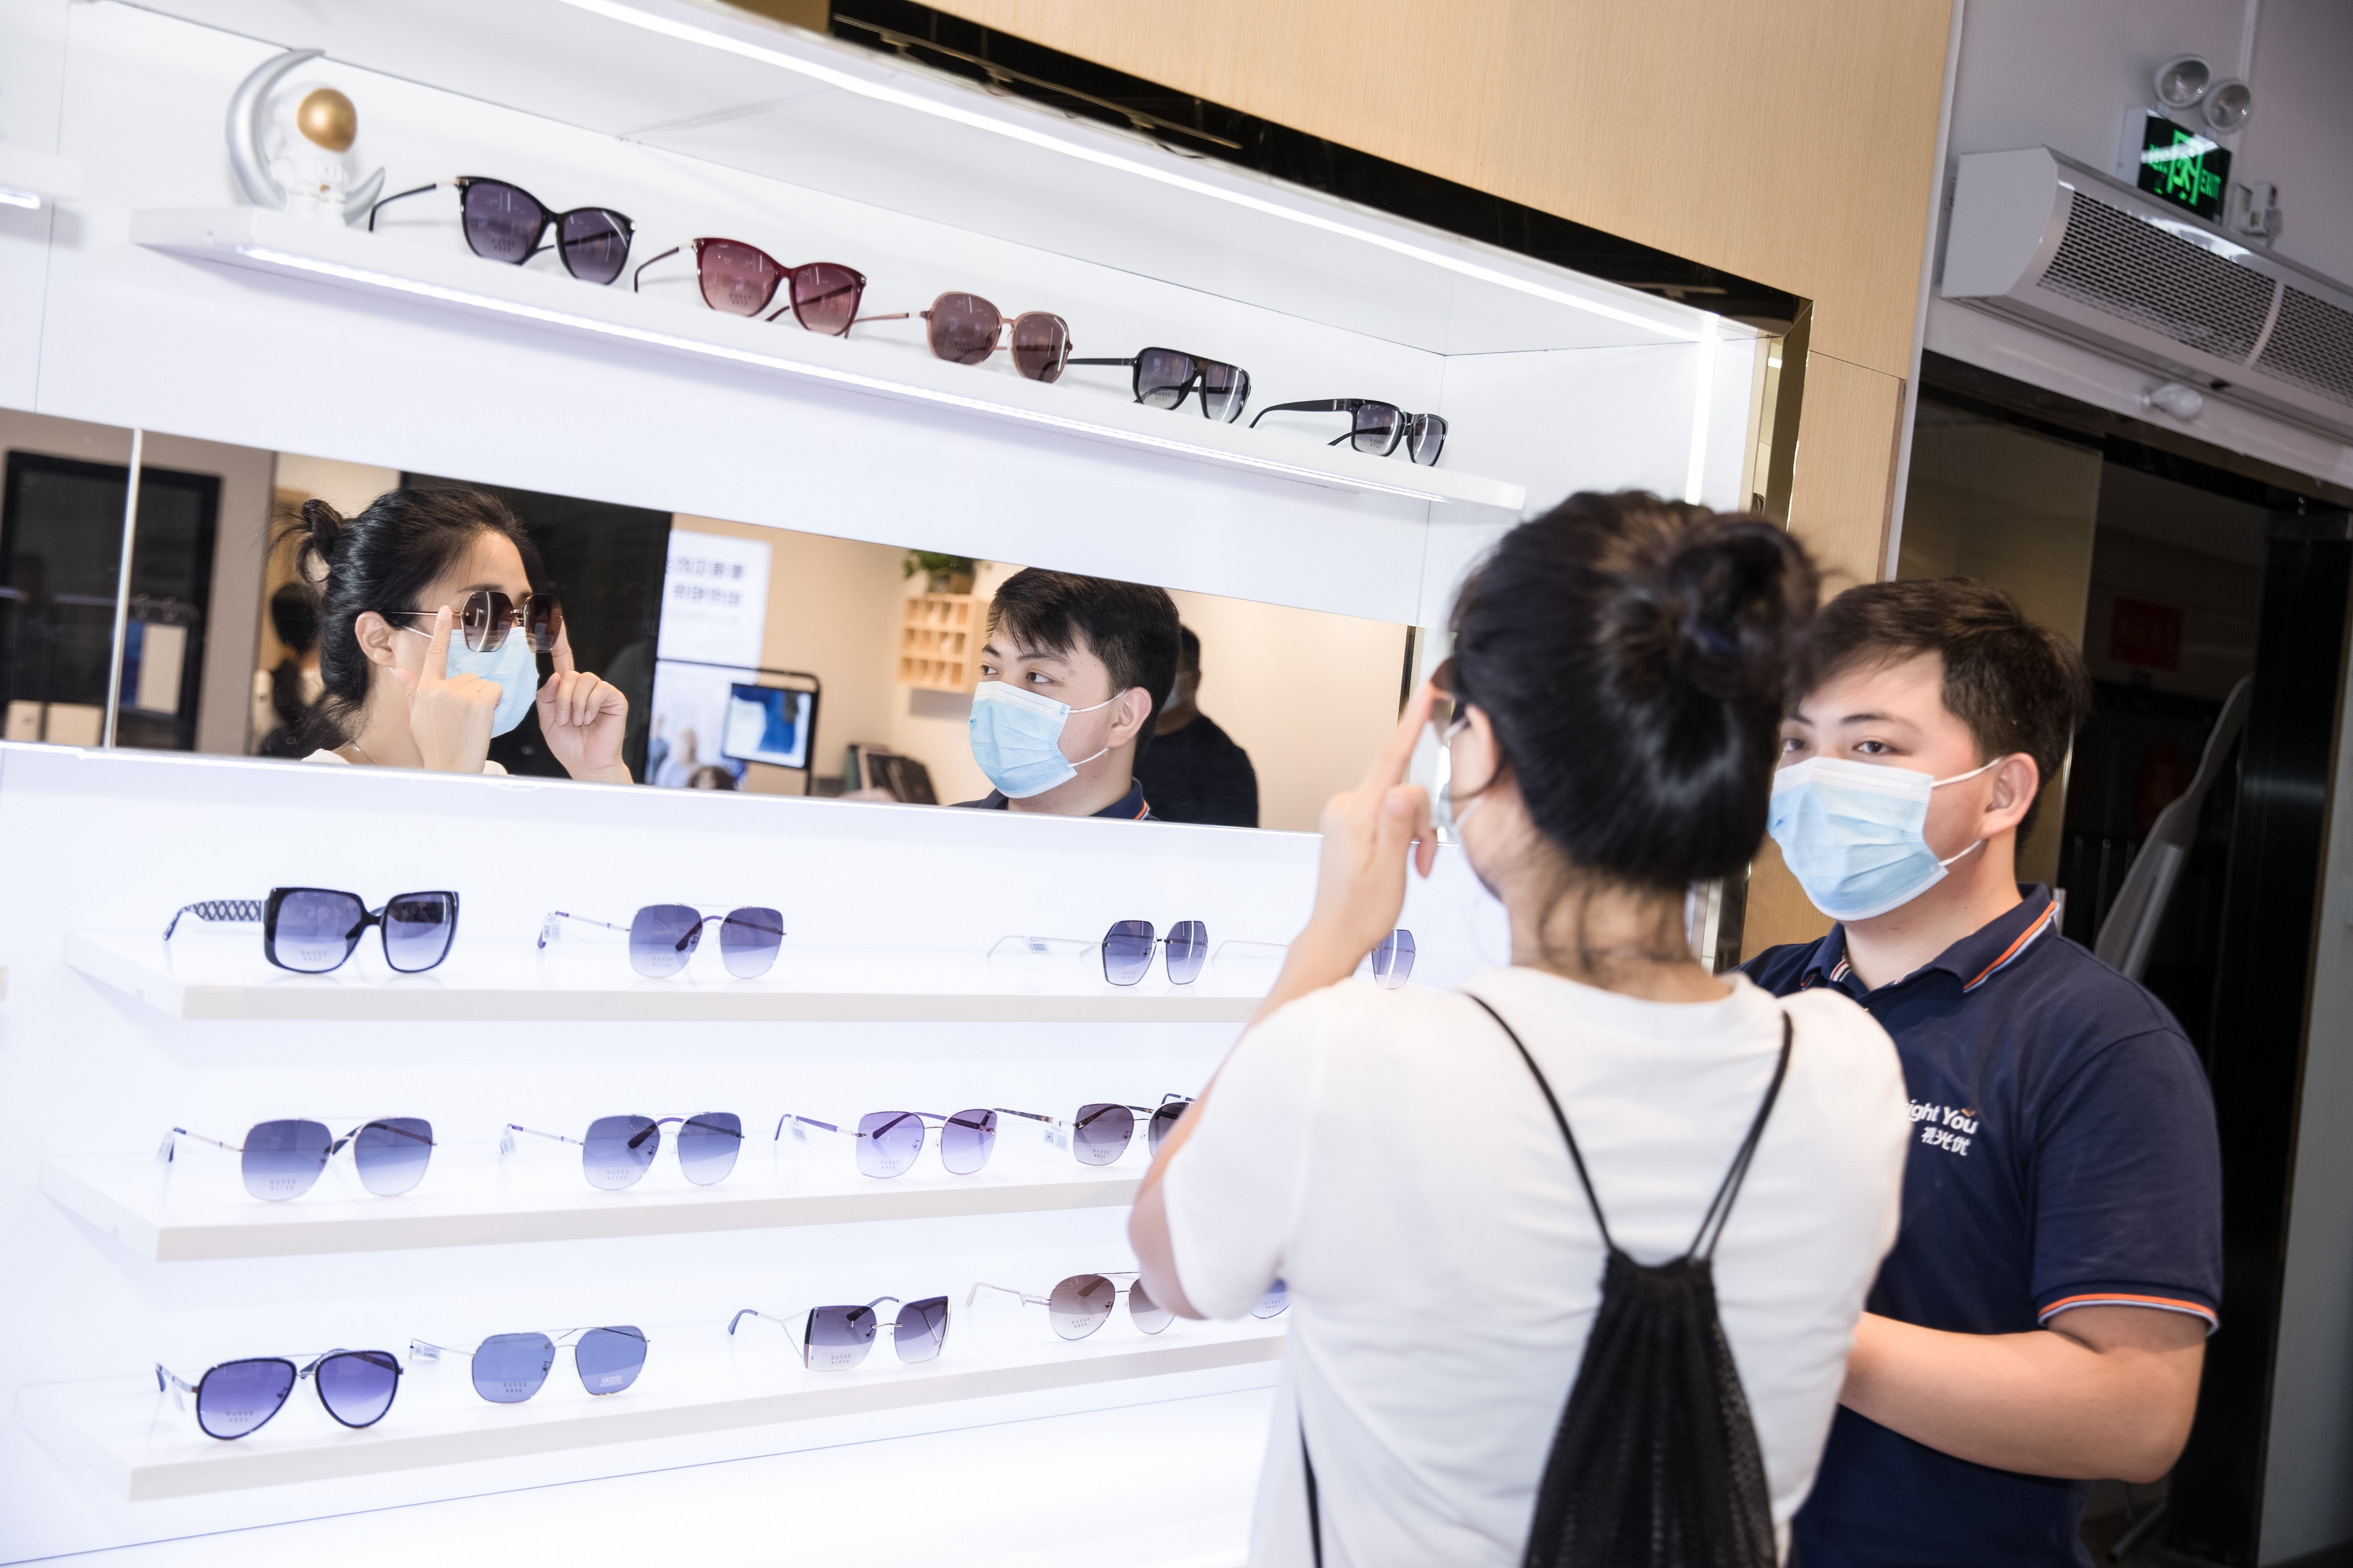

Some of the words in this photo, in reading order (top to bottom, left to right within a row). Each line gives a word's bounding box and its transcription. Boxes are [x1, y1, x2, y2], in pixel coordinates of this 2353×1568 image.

[2199, 168, 2222, 200] EXIT
[1906, 1099, 1941, 1122] ight
[1942, 1105, 1979, 1134] You
[601, 1375, 623, 1383] GUESS
